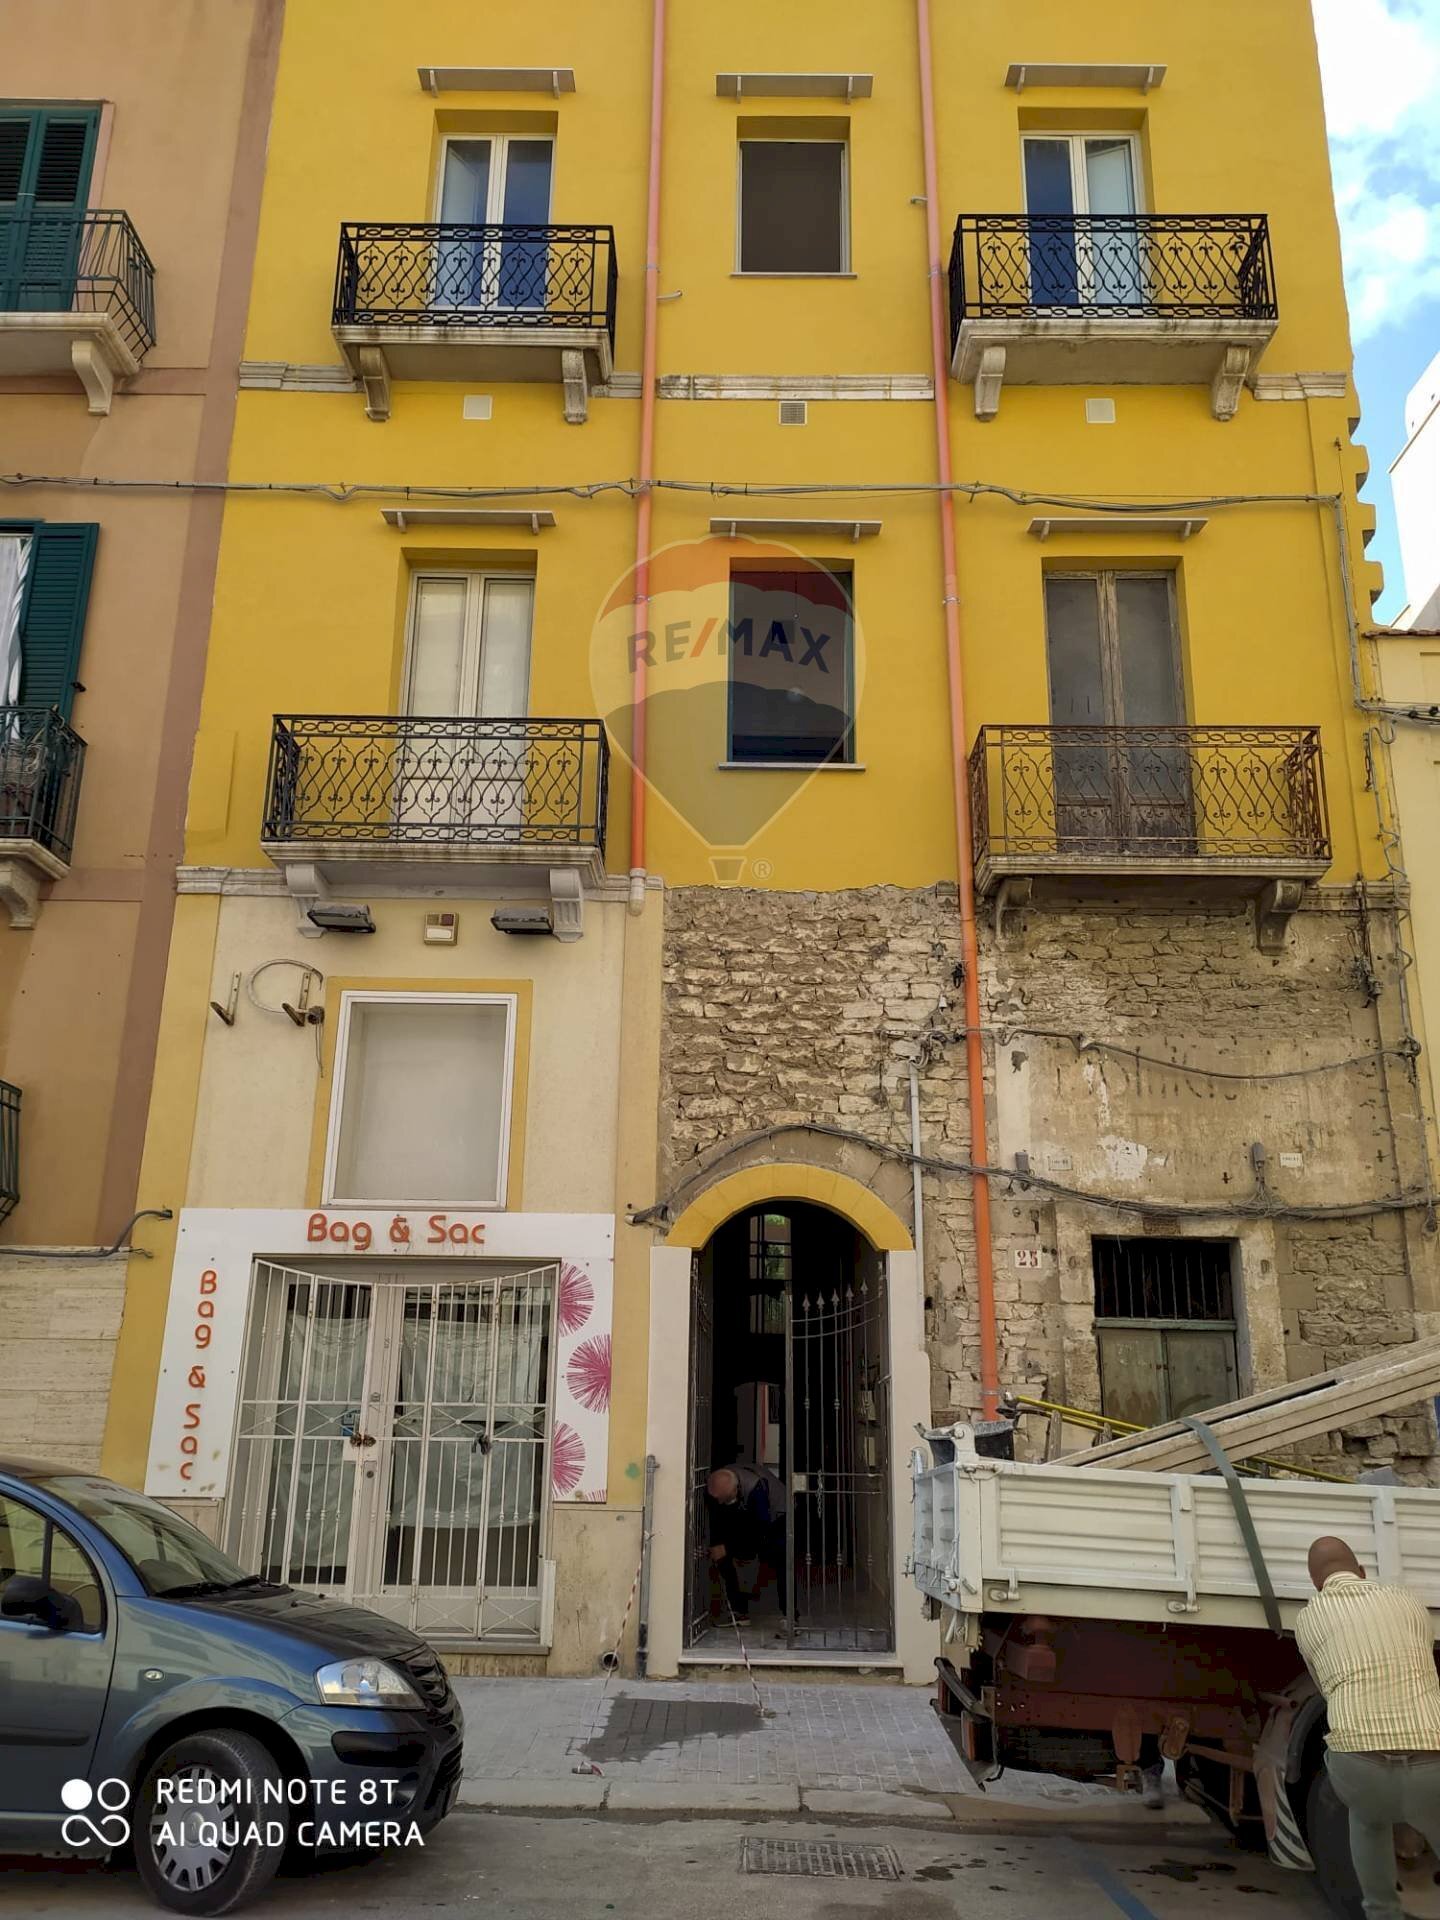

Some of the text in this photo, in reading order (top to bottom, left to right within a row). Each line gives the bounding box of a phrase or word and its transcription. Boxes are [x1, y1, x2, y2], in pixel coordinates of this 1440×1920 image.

[307, 1213, 486, 1251] Bag & Sac
[179, 1270, 218, 1481] Bag & Sac
